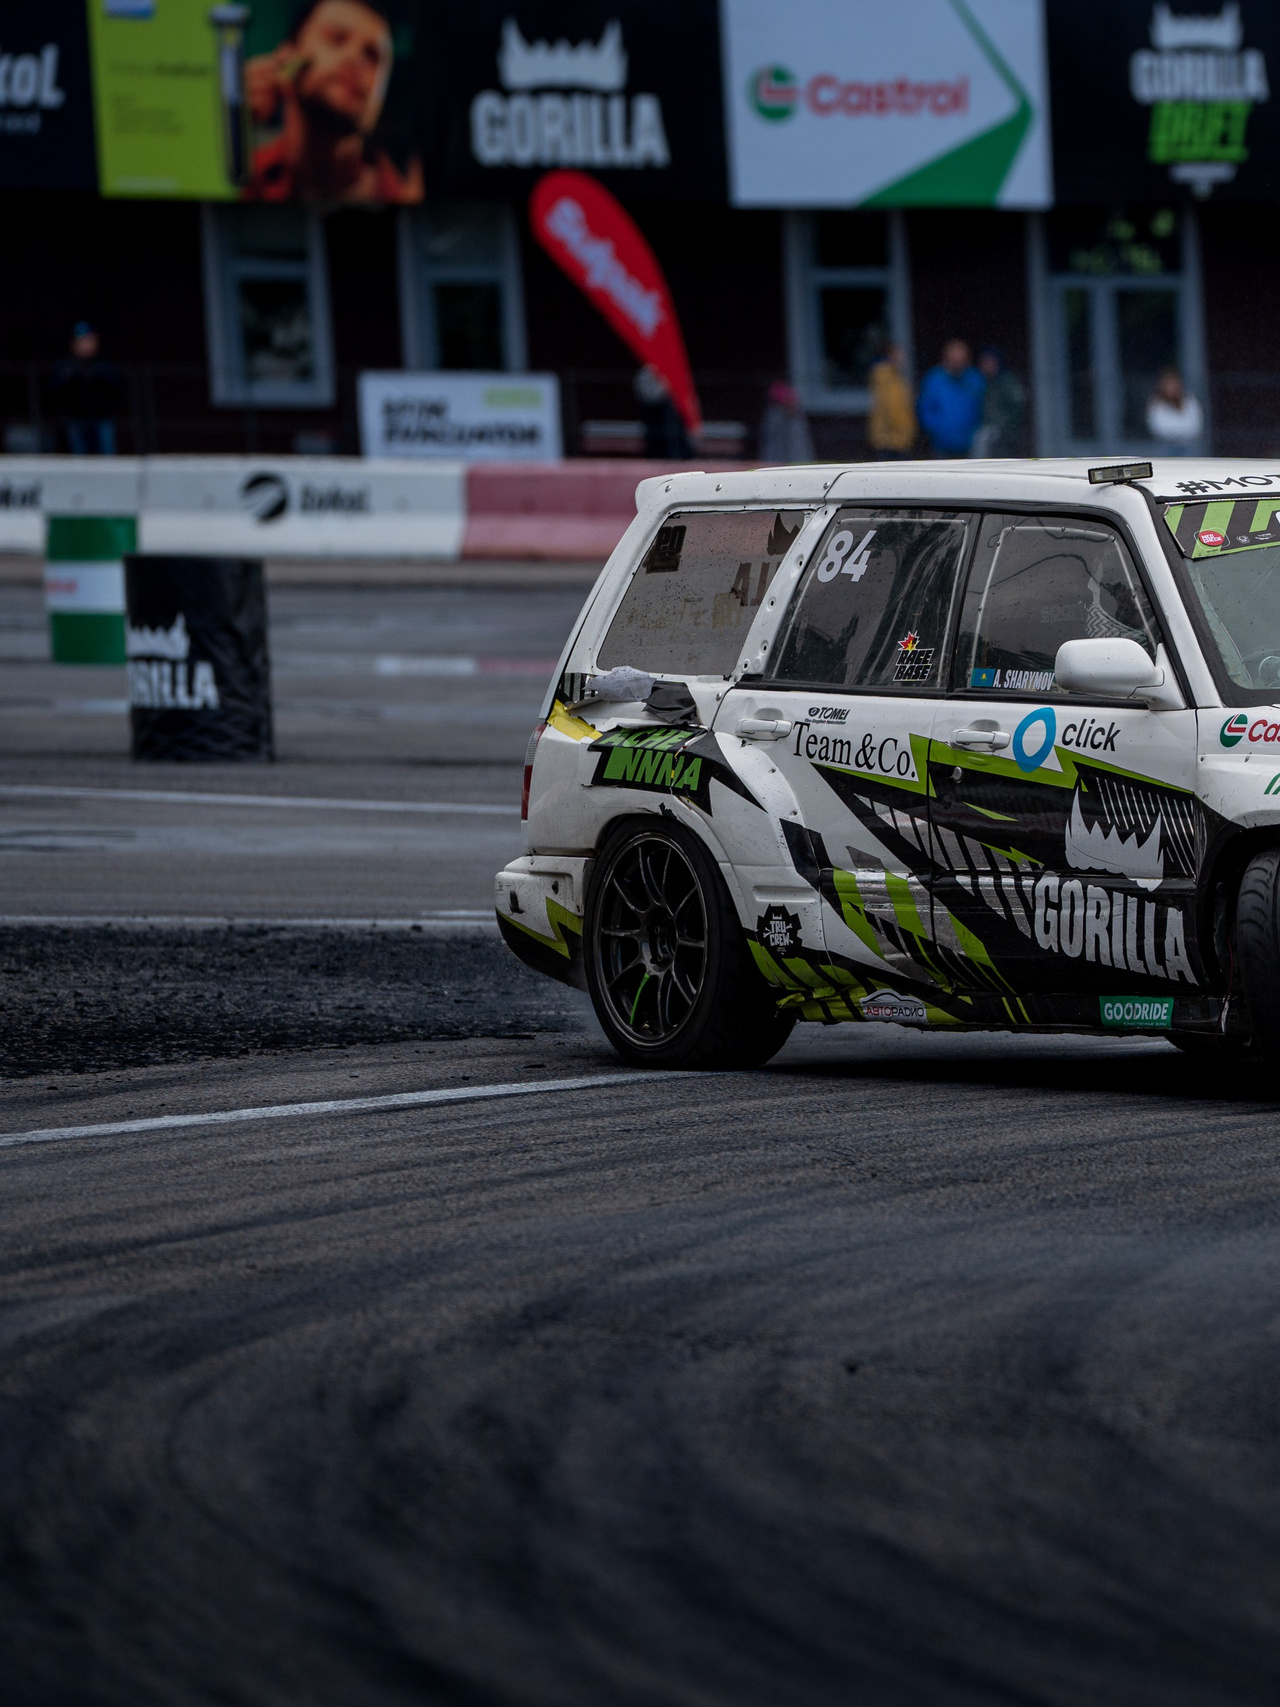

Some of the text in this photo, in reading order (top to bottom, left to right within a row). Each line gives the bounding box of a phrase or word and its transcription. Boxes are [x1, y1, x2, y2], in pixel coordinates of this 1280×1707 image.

[808, 74, 970, 116] Castrol
[472, 92, 670, 166] GORILLA
[817, 530, 877, 583] 84
[896, 648, 935, 666] RACE
[893, 664, 932, 682] BASE
[992, 669, 1055, 691] A. SHARYMOV
[819, 707, 851, 720] TOMEI
[1061, 718, 1121, 752] click
[770, 921, 787, 934] TRU
[1034, 871, 1199, 986] GORILLA
[770, 932, 790, 946] CREW
[1104, 1002, 1169, 1020] GOODRIDE
